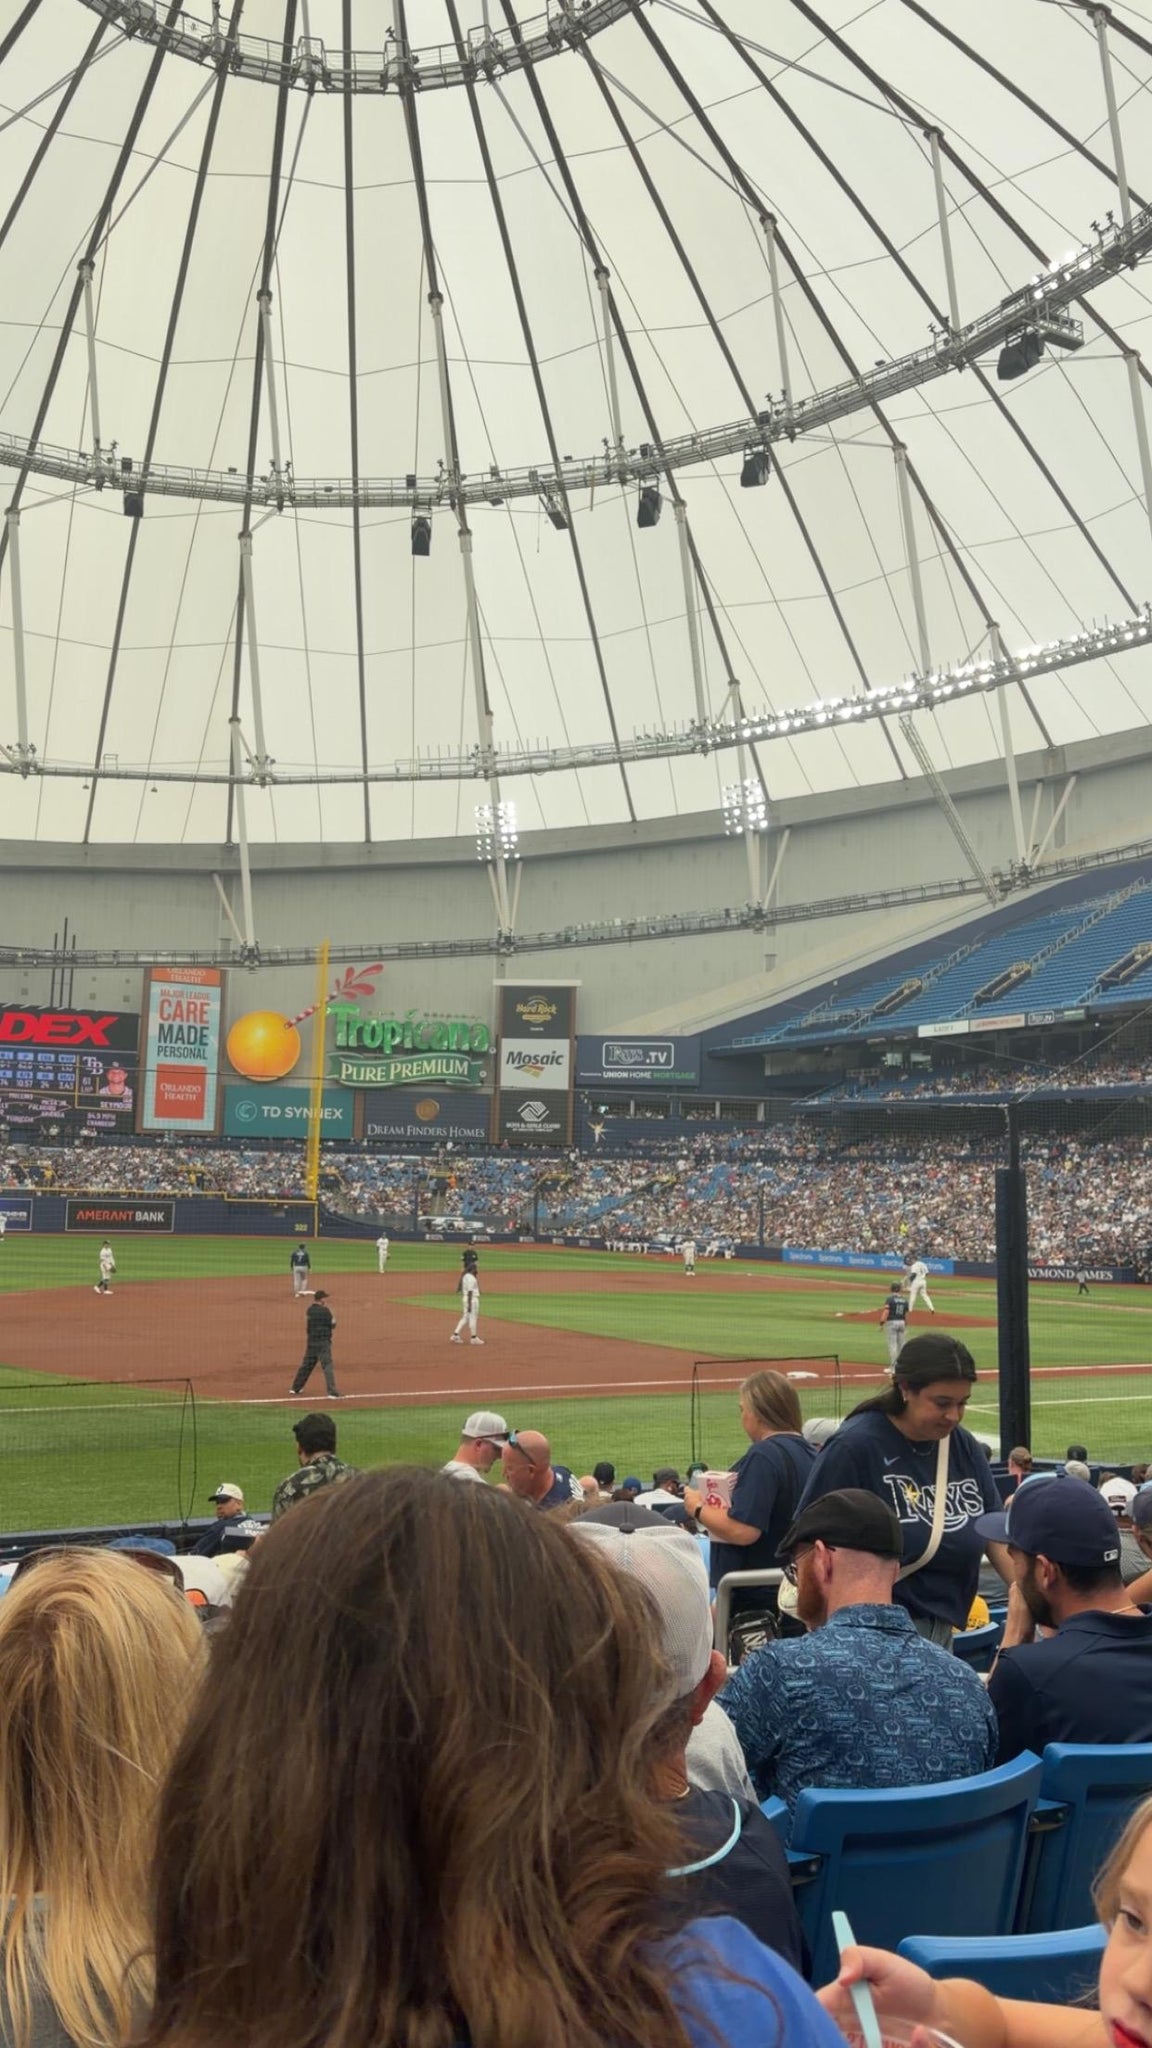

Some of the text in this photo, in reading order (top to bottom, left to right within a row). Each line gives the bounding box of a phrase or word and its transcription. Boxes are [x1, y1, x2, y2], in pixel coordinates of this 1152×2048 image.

[159, 998, 210, 1025] CARE
[0, 1011, 118, 1046] DEX
[158, 1023, 210, 1047] MADE
[326, 1002, 489, 1054] Tropicana
[157, 1045, 209, 1060] PERSONAL
[506, 1050, 564, 1066] Mosaic
[341, 1058, 469, 1082] PURE PREMIUM
[603, 1071, 629, 1079] UNION
[629, 1071, 652, 1080] HOME
[653, 1072, 696, 1080] MORTGAGE
[160, 1082, 202, 1094] ORLANDO
[164, 1091, 198, 1101] HEALTH
[261, 1106, 281, 1118] TD
[367, 1123, 486, 1138] DREAM FINDERS HOMES
[76, 1210, 165, 1222] AMERANT BANK
[1028, 1268, 1113, 1280] AYMOND AMES
